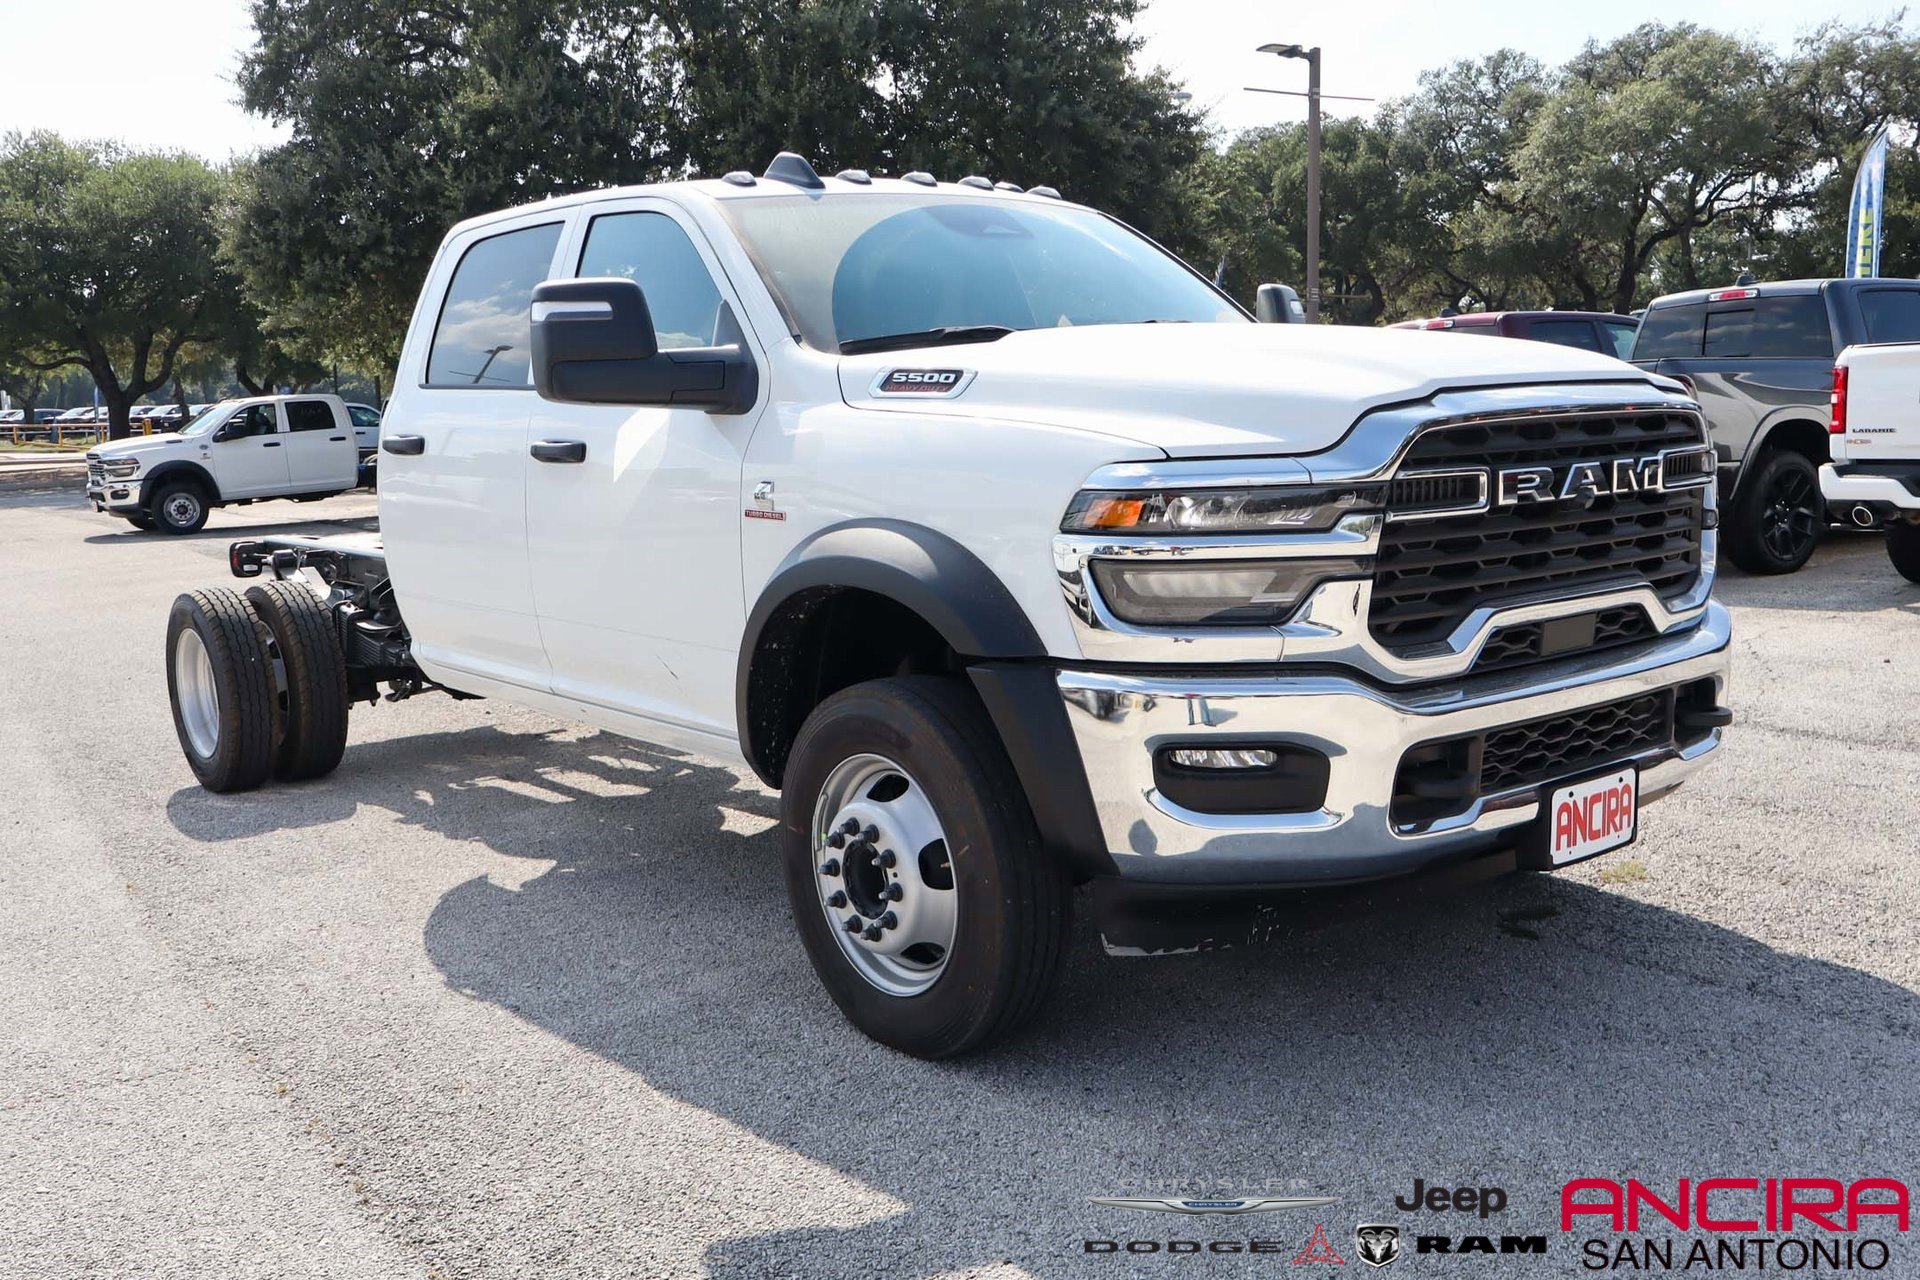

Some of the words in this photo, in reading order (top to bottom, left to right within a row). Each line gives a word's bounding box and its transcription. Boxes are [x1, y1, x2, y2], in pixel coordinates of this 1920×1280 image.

[891, 372, 956, 383] 5500
[1498, 455, 1661, 506] RAM
[1556, 783, 1632, 851] ANCIRA
